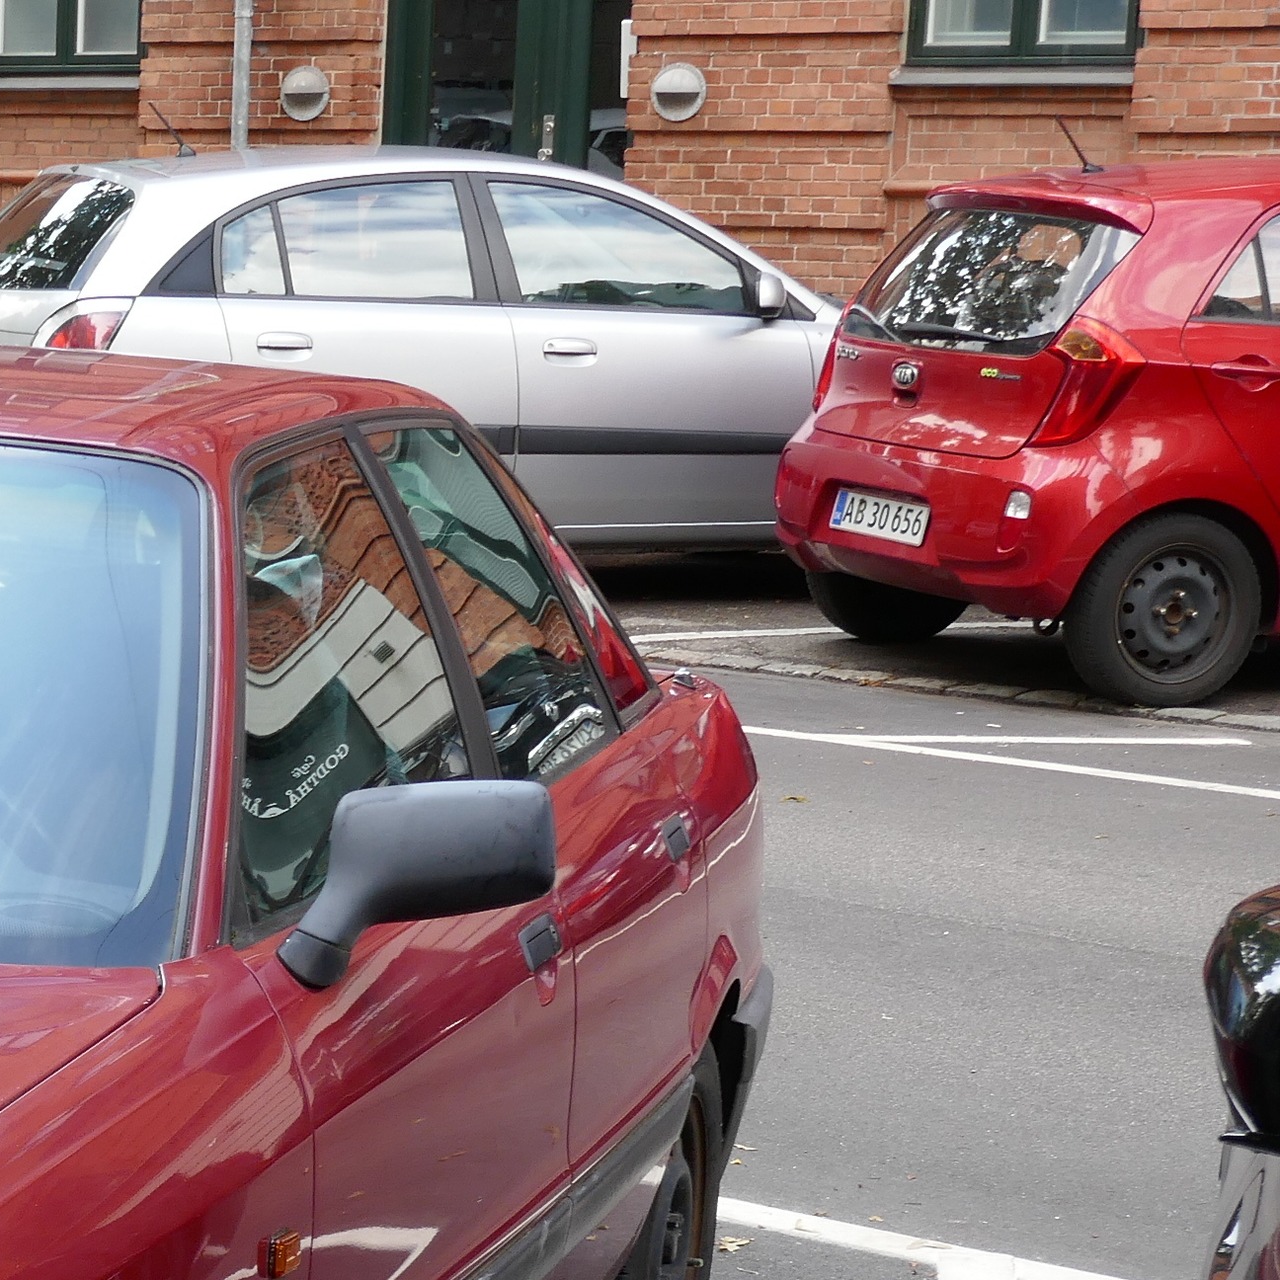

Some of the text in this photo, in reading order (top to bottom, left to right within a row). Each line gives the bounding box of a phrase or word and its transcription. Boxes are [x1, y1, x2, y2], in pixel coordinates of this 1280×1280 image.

[842, 496, 924, 536] AB 30 656
